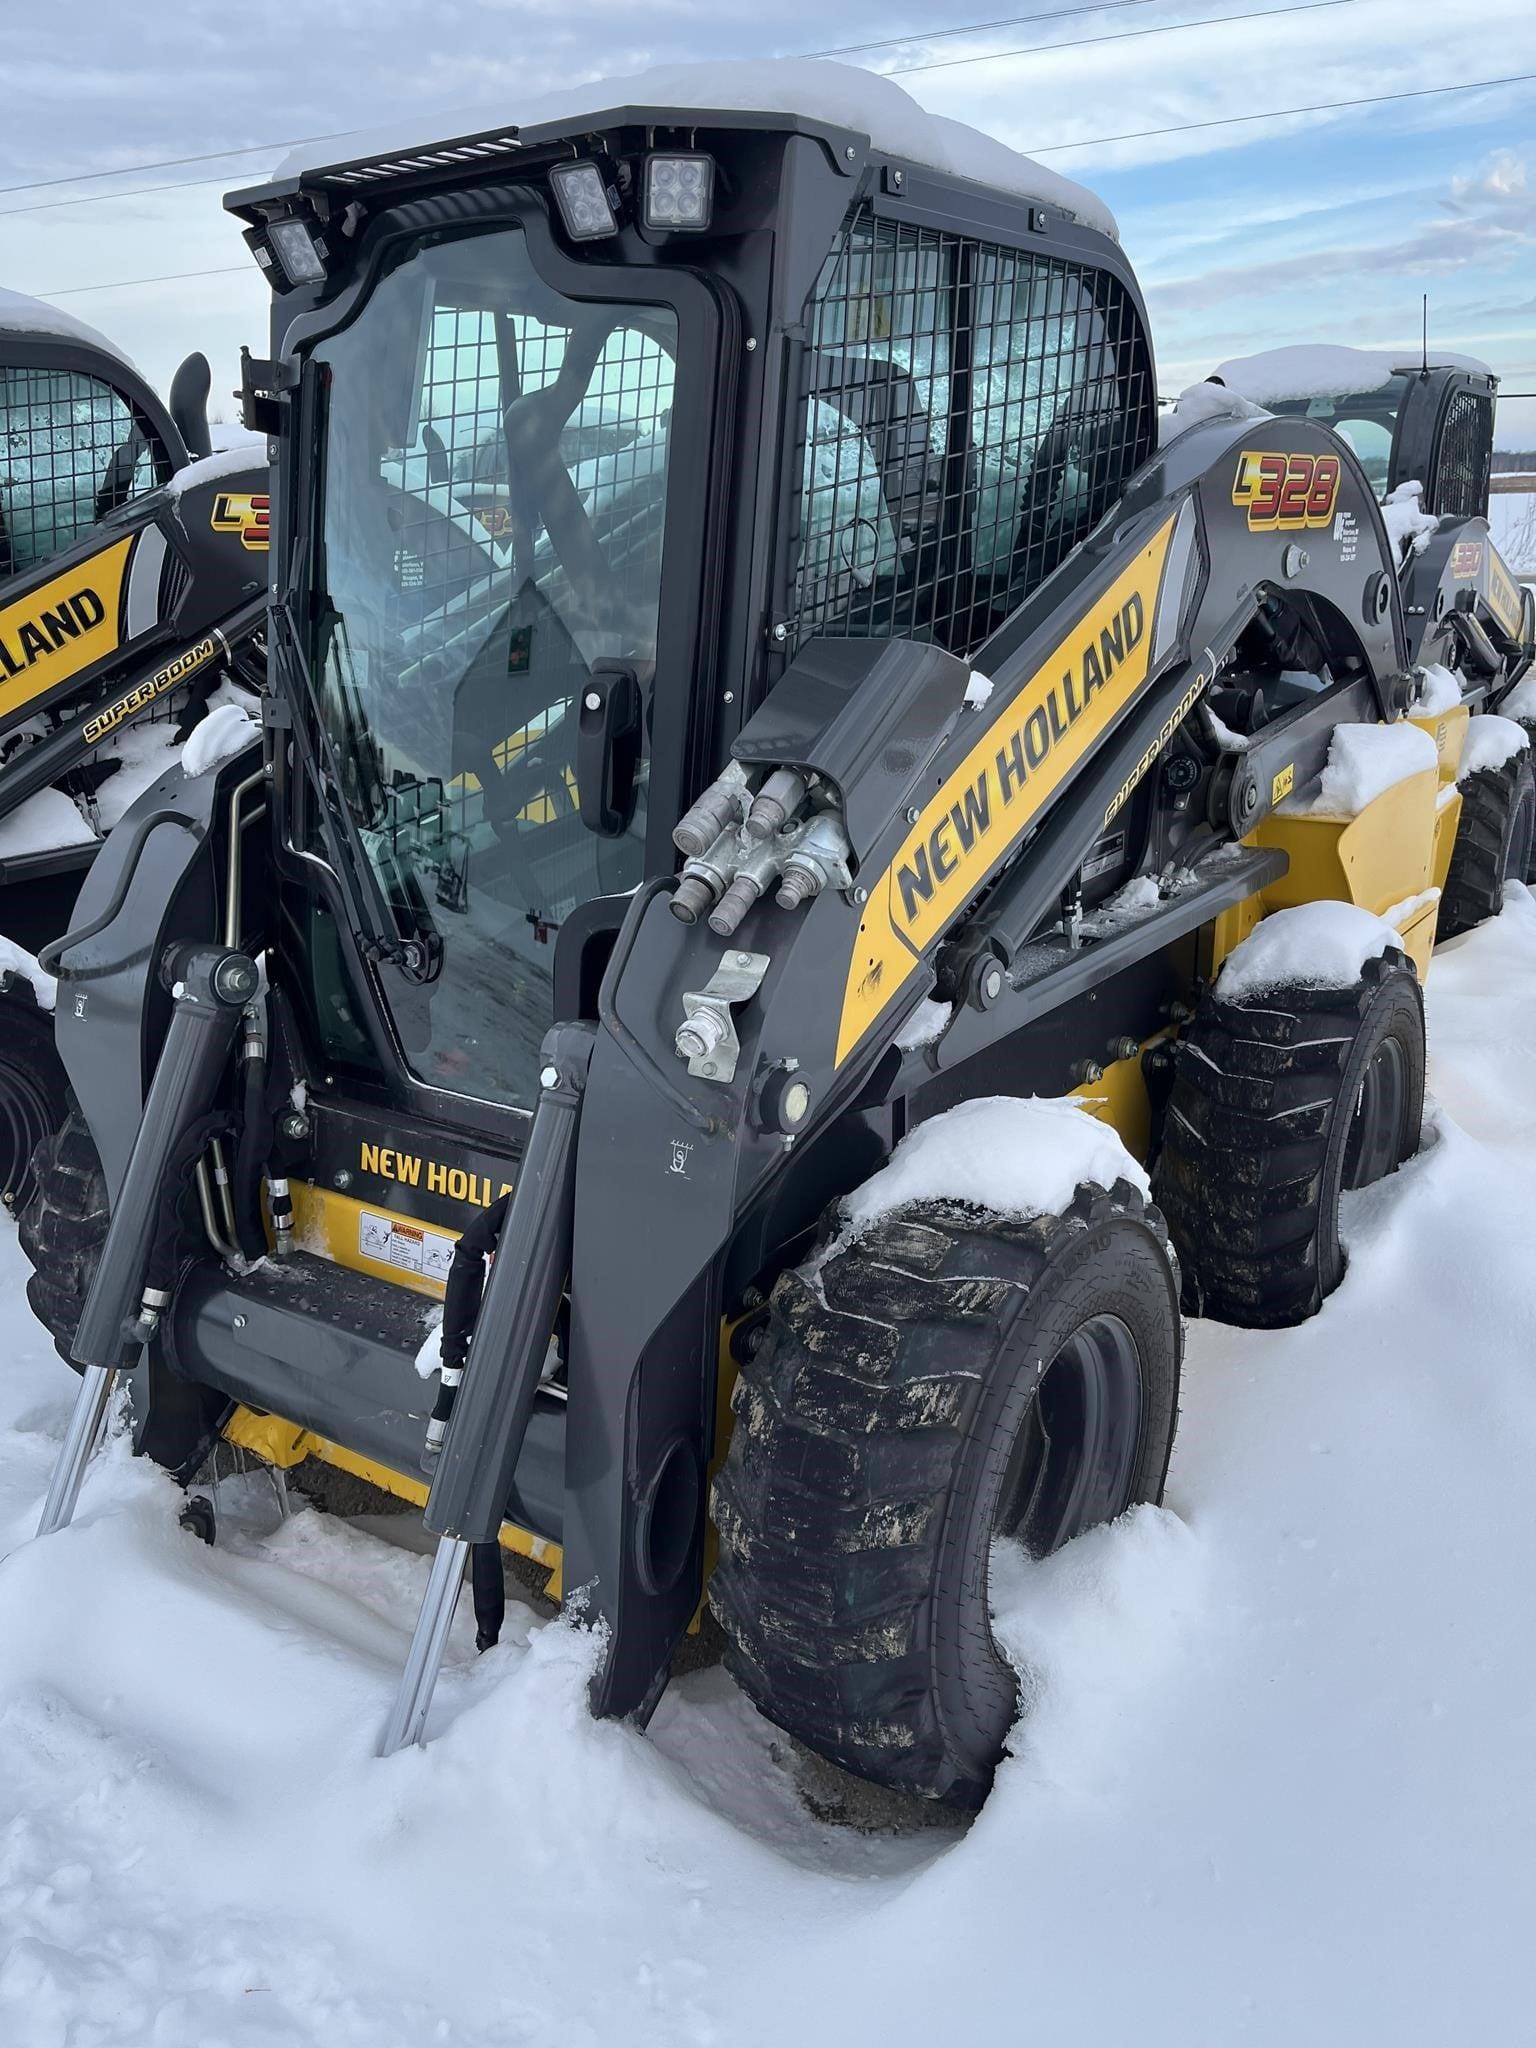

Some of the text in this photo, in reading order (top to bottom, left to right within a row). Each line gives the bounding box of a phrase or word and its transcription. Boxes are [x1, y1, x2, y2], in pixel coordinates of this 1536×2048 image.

[1232, 451, 1340, 531] L328
[0, 588, 105, 684] LAND
[83, 639, 213, 743] SUPER BOOM
[897, 591, 1143, 923] NEW HOLLAND
[361, 1142, 421, 1187] NEW
